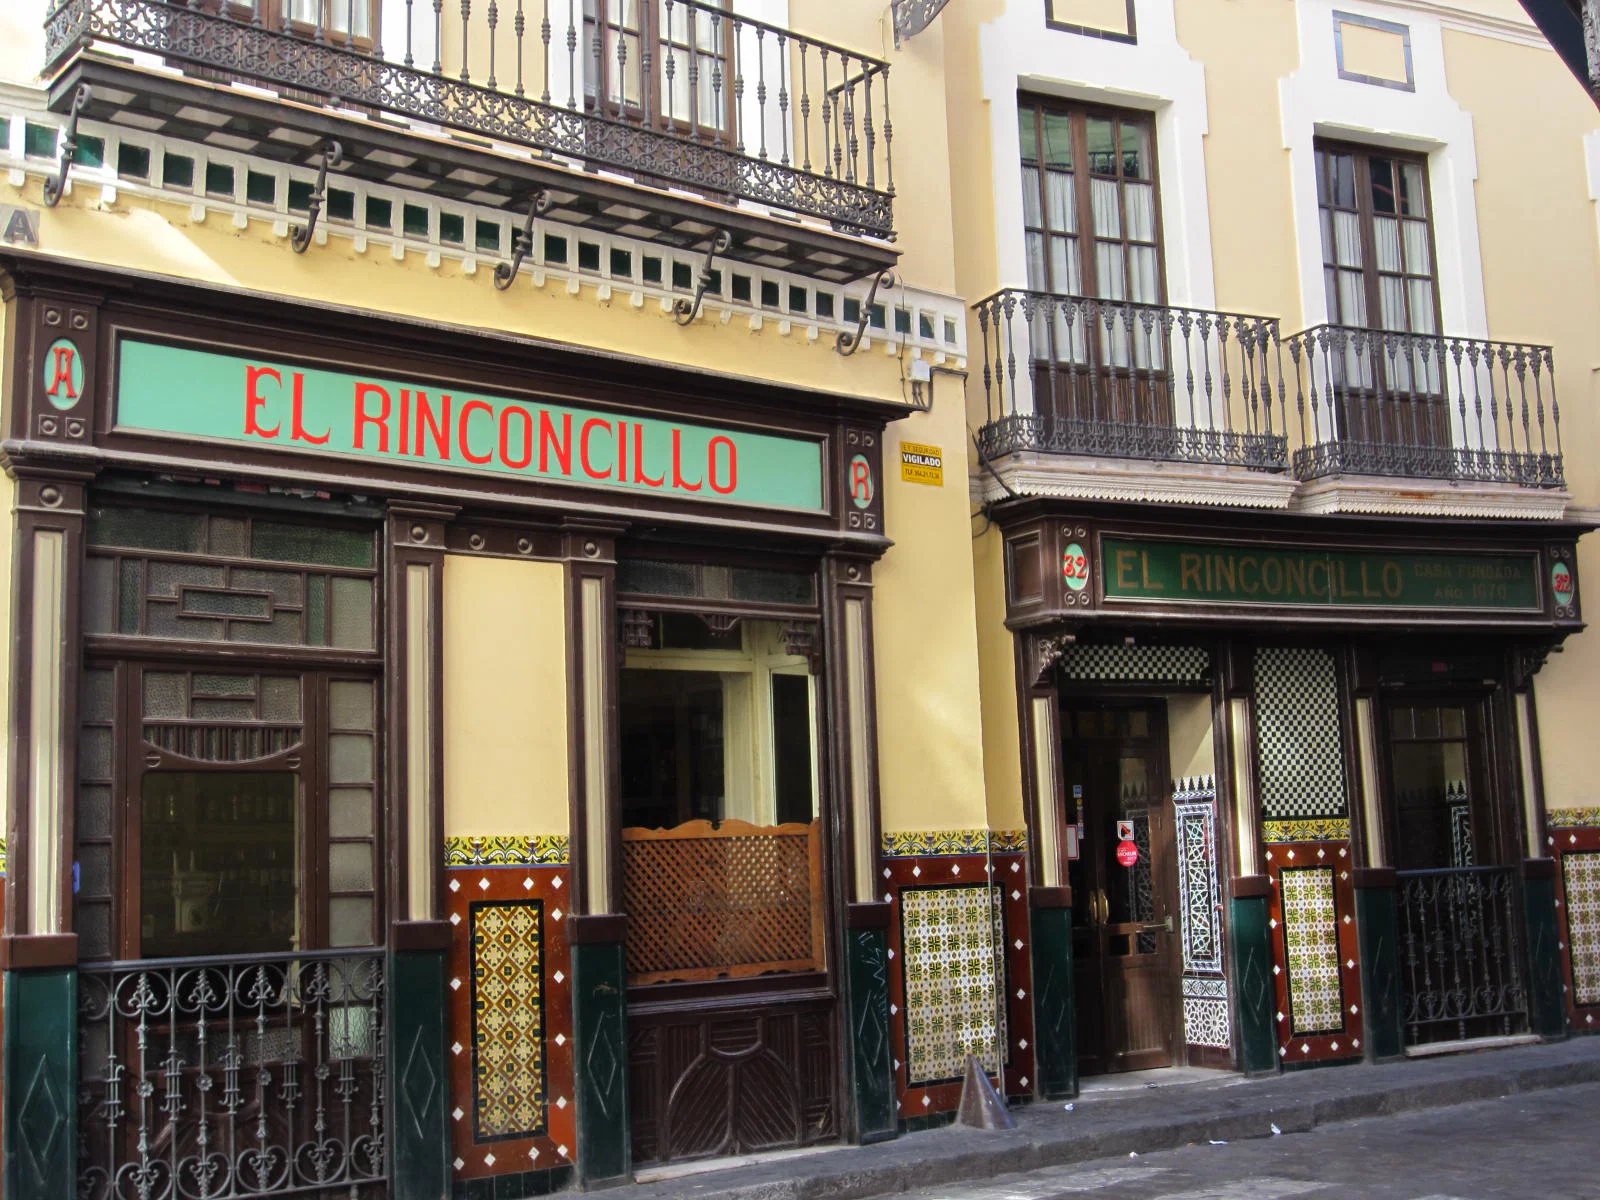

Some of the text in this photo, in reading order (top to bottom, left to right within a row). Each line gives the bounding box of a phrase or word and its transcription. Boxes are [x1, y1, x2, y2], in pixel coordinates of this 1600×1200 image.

[3, 209, 38, 247] A
[245, 365, 738, 495] EL RINCONCILLO
[903, 453, 941, 467] VIGILADO
[851, 462, 870, 500] R
[1063, 554, 1089, 578] 32
[1115, 549, 1404, 599] EL RINCONCILLO
[1413, 563, 1522, 580] CASA FUNDADA
[1554, 573, 1571, 592] 32
